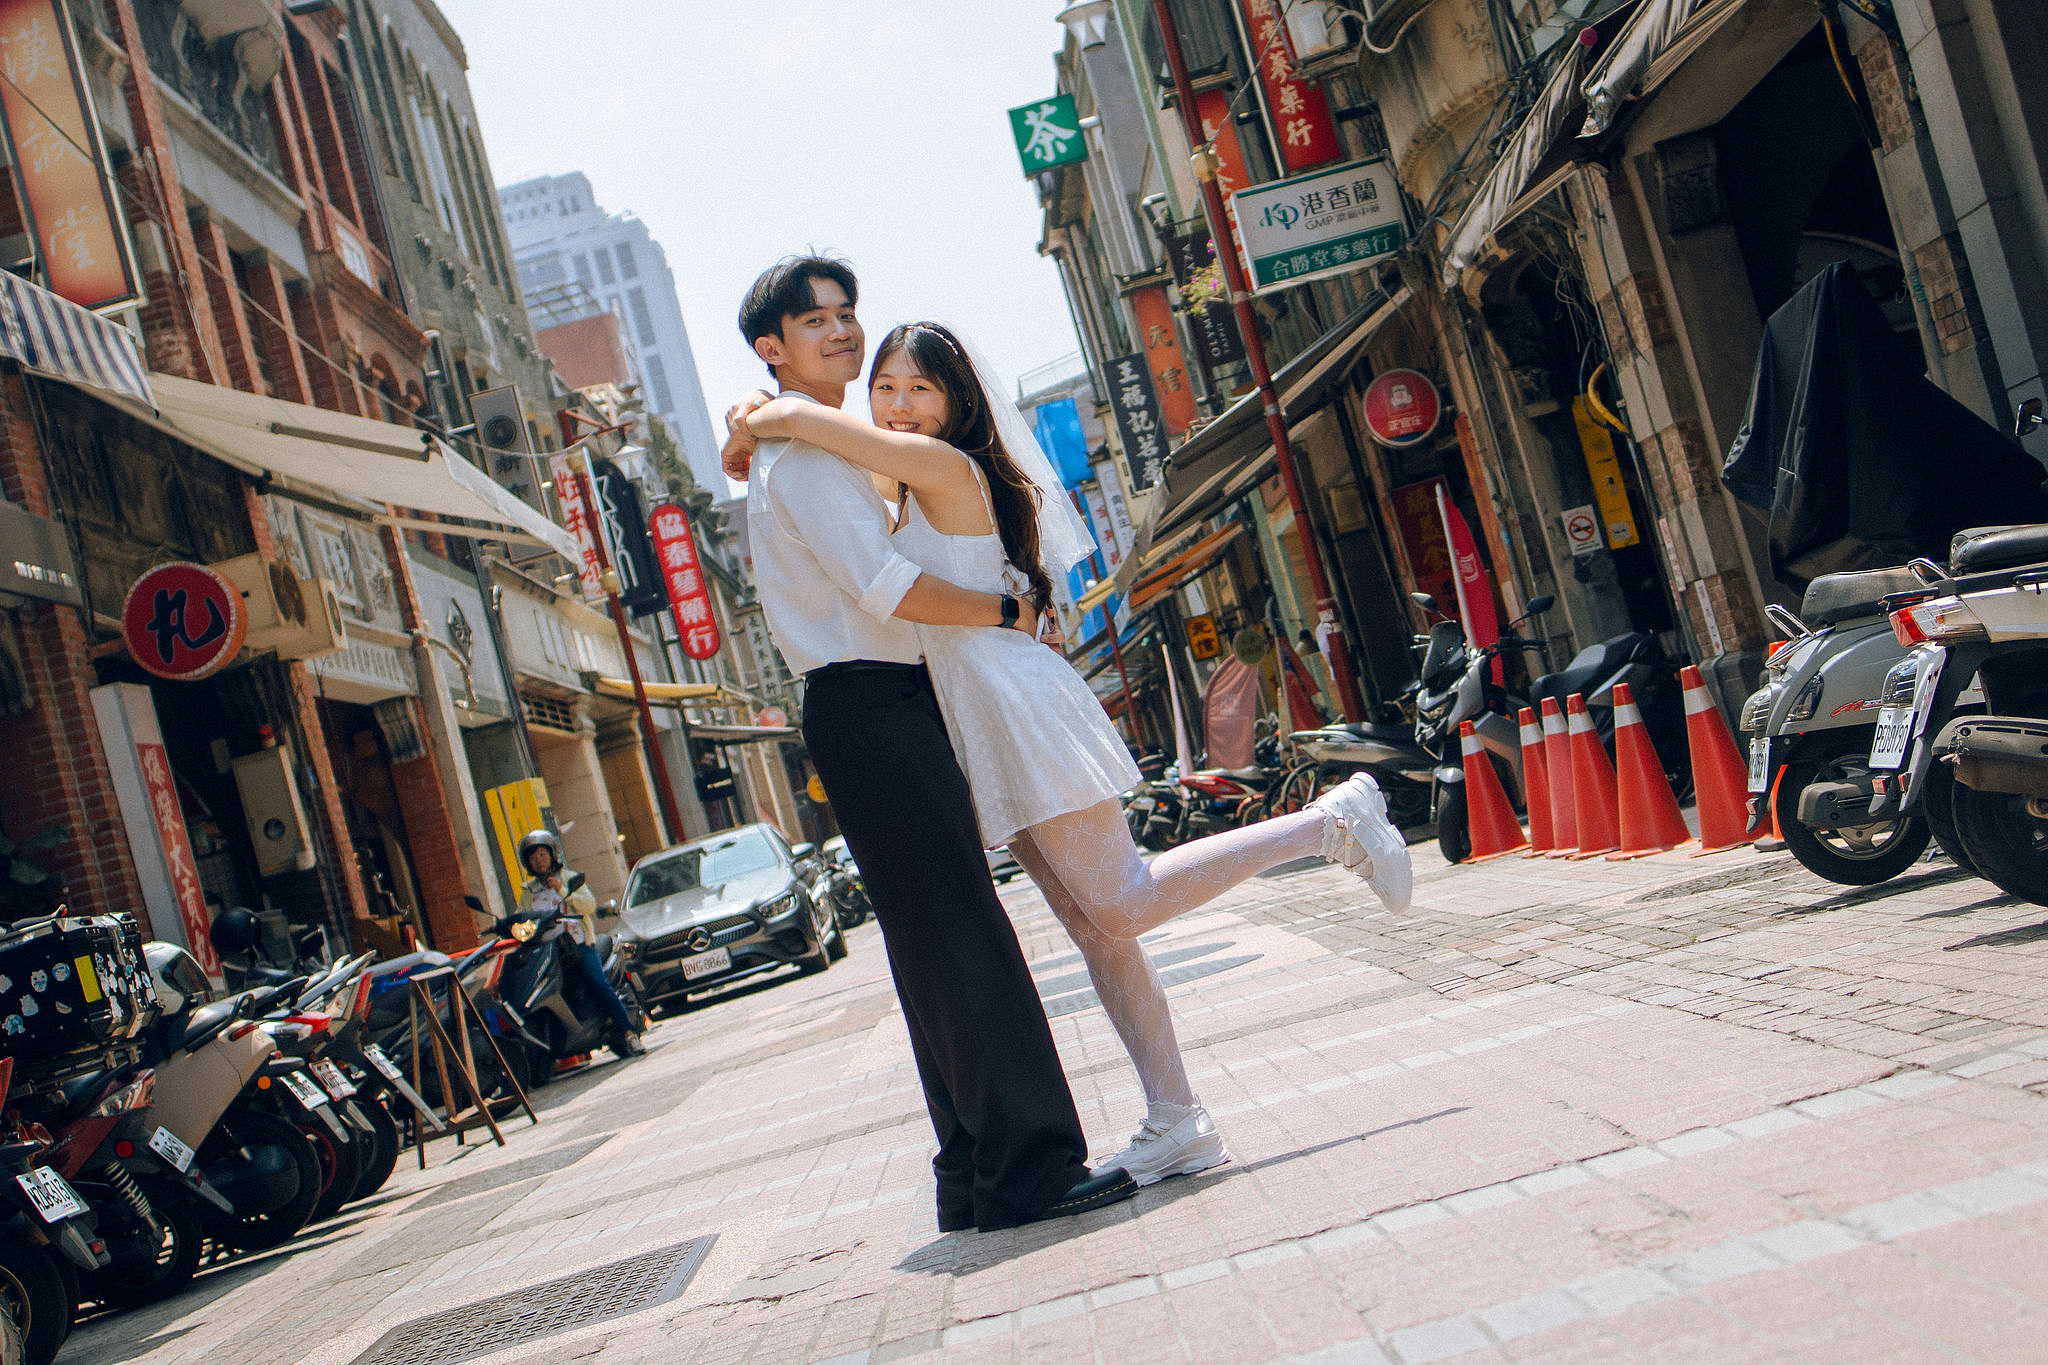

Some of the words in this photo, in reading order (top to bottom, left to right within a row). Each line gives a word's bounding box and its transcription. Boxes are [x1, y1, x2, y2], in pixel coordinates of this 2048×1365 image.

[1023, 103, 1077, 162] 茶
[1300, 178, 1378, 217] 港香蘭
[1148, 324, 1183, 395] 元信
